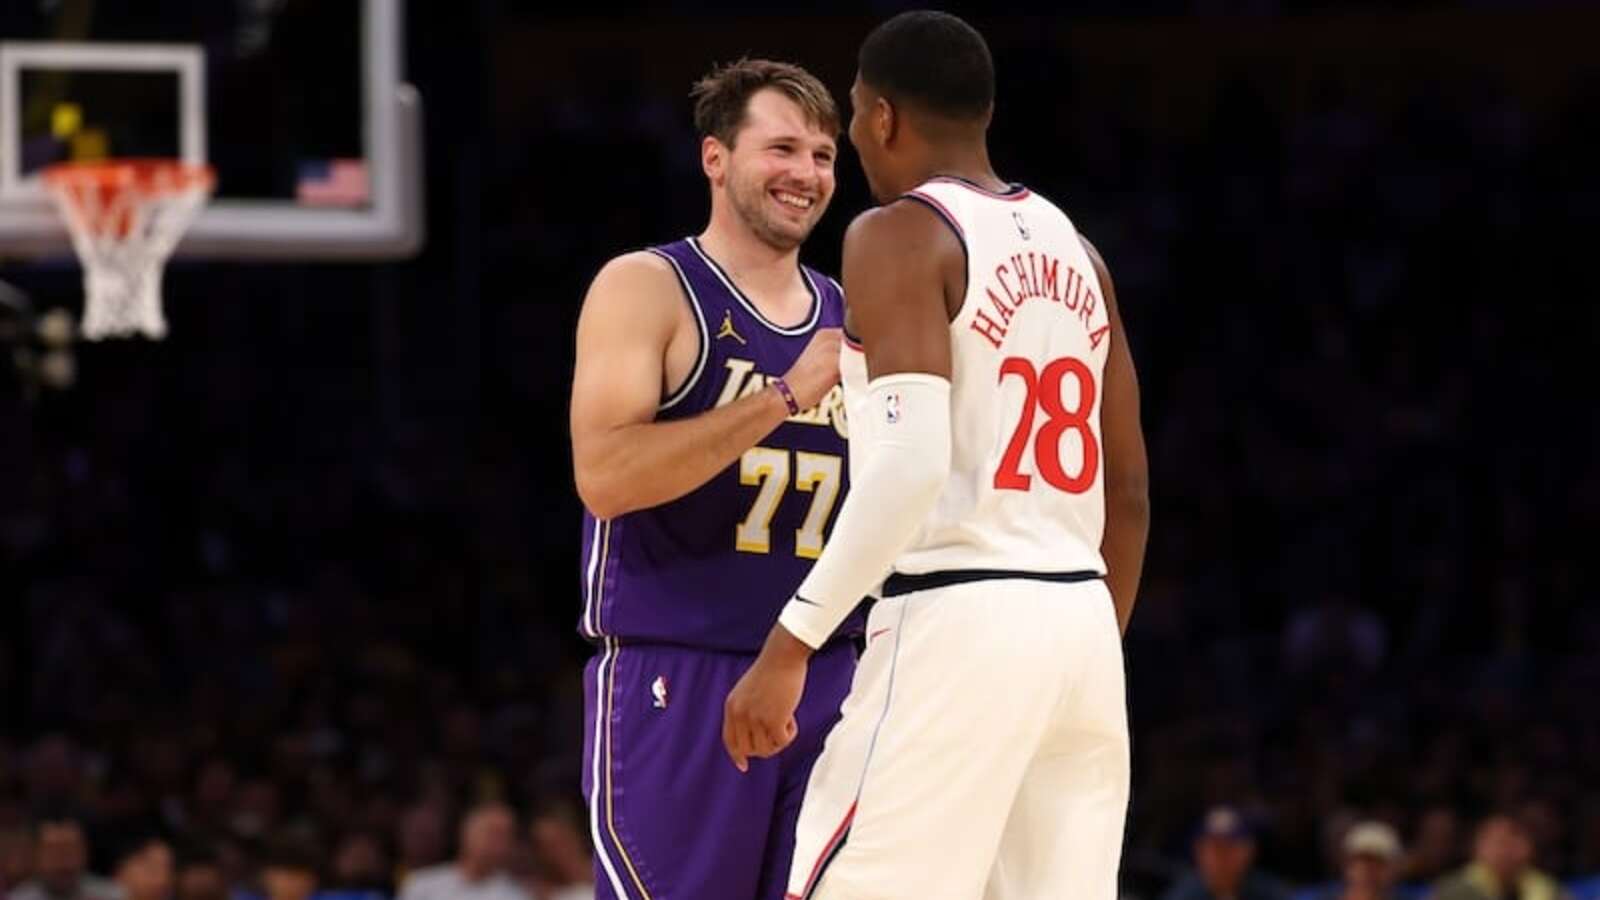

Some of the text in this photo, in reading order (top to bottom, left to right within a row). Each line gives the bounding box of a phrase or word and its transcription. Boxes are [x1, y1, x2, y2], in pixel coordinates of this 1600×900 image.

[970, 252, 1111, 350] HACHIMURA
[993, 356, 1099, 494] 28
[735, 446, 843, 560] 77
